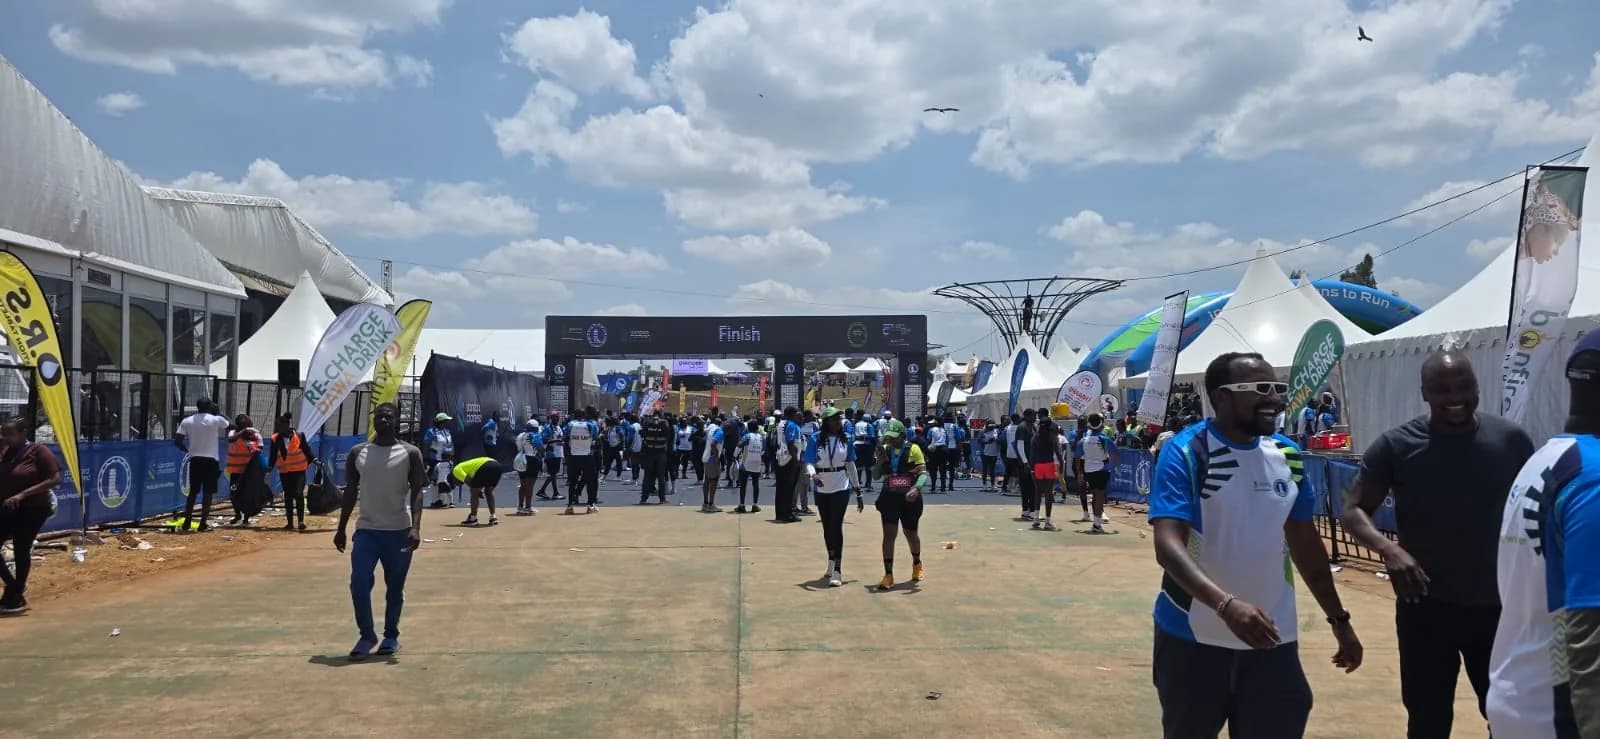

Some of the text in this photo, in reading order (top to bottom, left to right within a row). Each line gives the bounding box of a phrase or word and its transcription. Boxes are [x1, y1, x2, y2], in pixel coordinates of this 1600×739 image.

[1320, 288, 1390, 309] ns to Run
[352, 323, 393, 371] DRINK
[719, 325, 760, 341] Finish
[304, 311, 381, 405] RE-CHARGE
[1286, 333, 1336, 402] E-CHARGE
[1310, 346, 1338, 386] DRINK
[1285, 384, 1312, 418] DAWA
